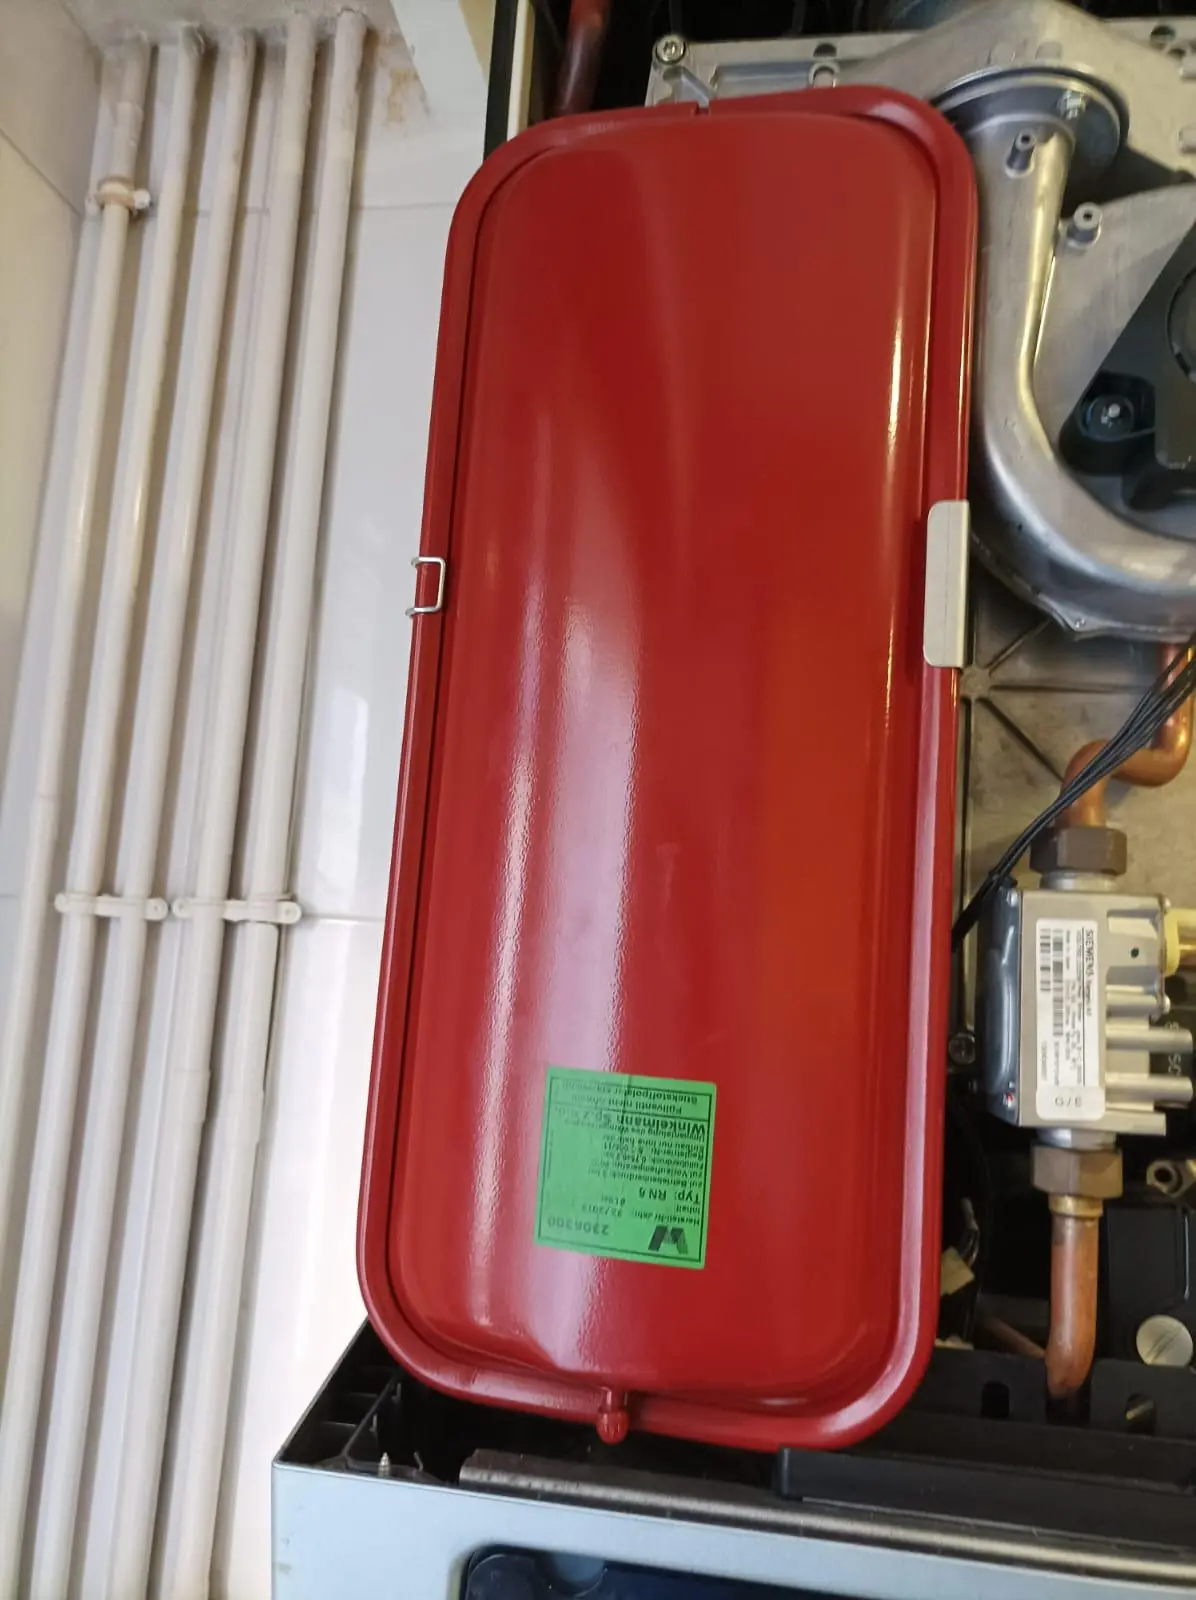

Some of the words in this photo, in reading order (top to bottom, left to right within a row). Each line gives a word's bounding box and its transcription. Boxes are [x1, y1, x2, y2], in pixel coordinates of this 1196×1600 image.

[1085, 930, 1095, 977] SIEMENS
[636, 1101, 682, 1116] Füllventil
[617, 1115, 705, 1137] Winkelmann
[649, 1189, 666, 1201] RN
